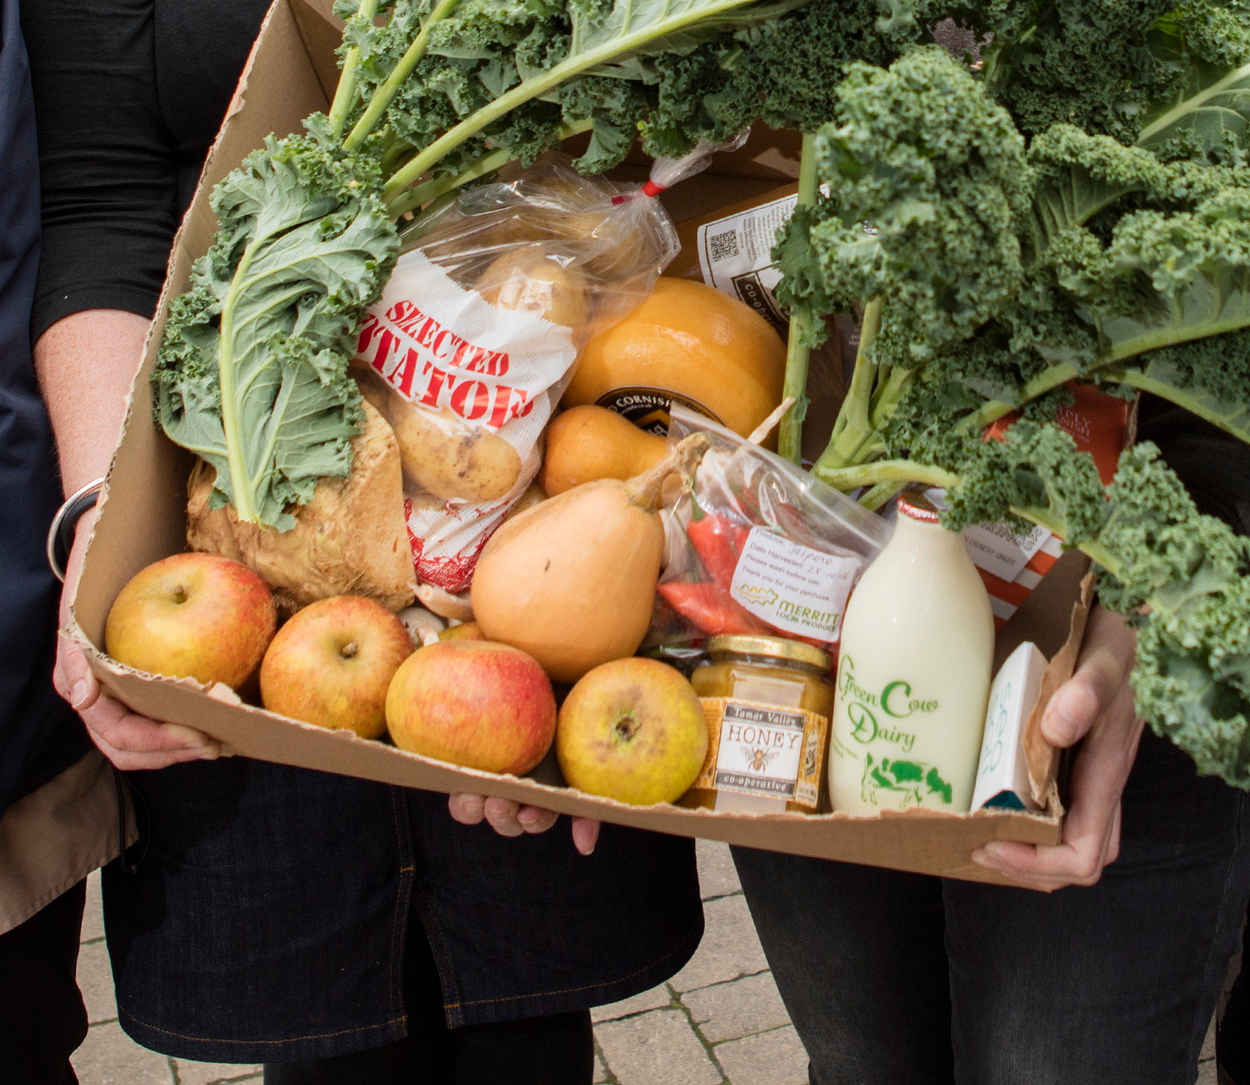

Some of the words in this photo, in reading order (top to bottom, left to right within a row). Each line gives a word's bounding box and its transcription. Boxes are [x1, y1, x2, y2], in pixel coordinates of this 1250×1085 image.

[779, 600, 839, 624] MERRITT
[838, 654, 878, 701] Green
[880, 680, 938, 718] Cow
[734, 707, 763, 720] Tamar
[767, 712, 796, 726] Valley
[848, 701, 916, 752] Dairy
[727, 725, 799, 749] HONEY
[723, 775, 787, 791] co-operative
